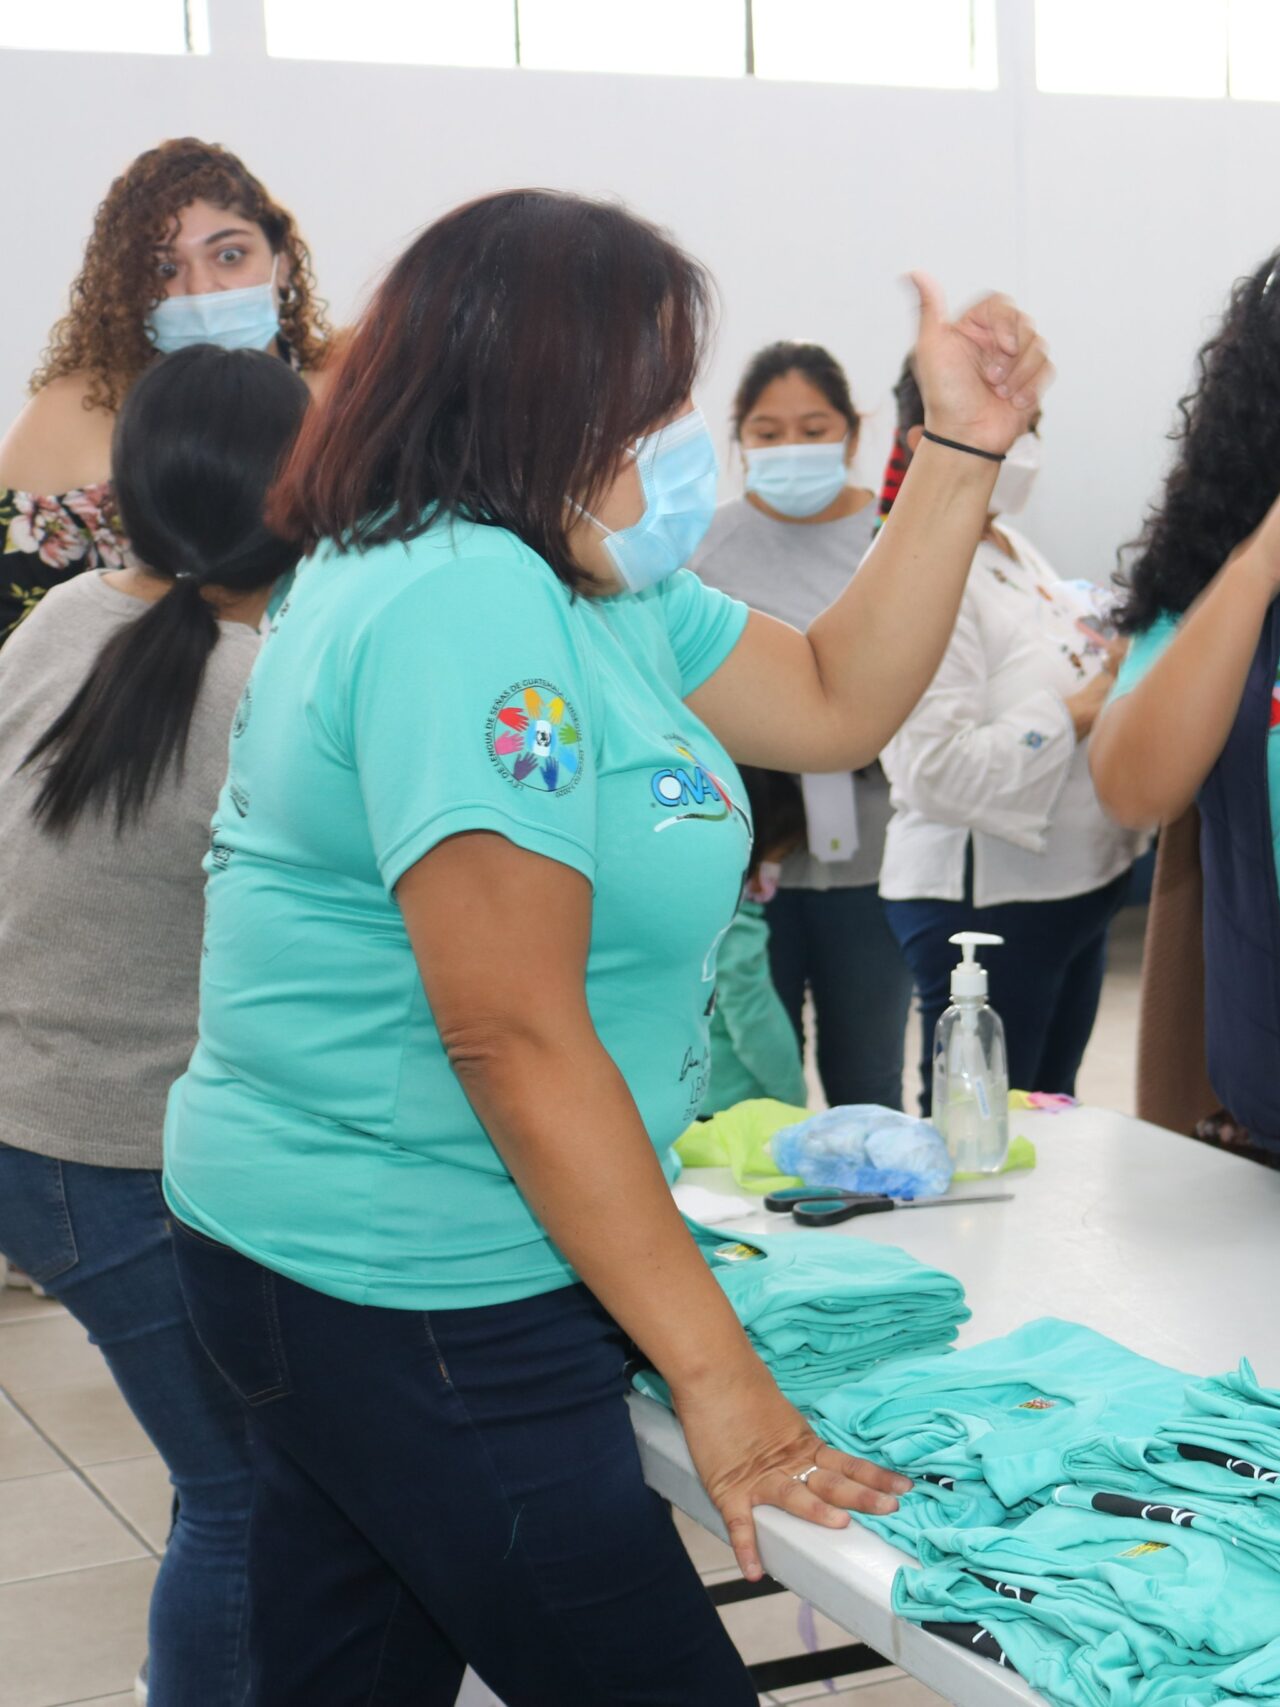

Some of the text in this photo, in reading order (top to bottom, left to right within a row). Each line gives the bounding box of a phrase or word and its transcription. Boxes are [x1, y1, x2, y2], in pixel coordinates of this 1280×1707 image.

[490, 690, 511, 716] SEÑAS
[485, 717, 495, 730] DE
[485, 732, 498, 767] LENGUA
